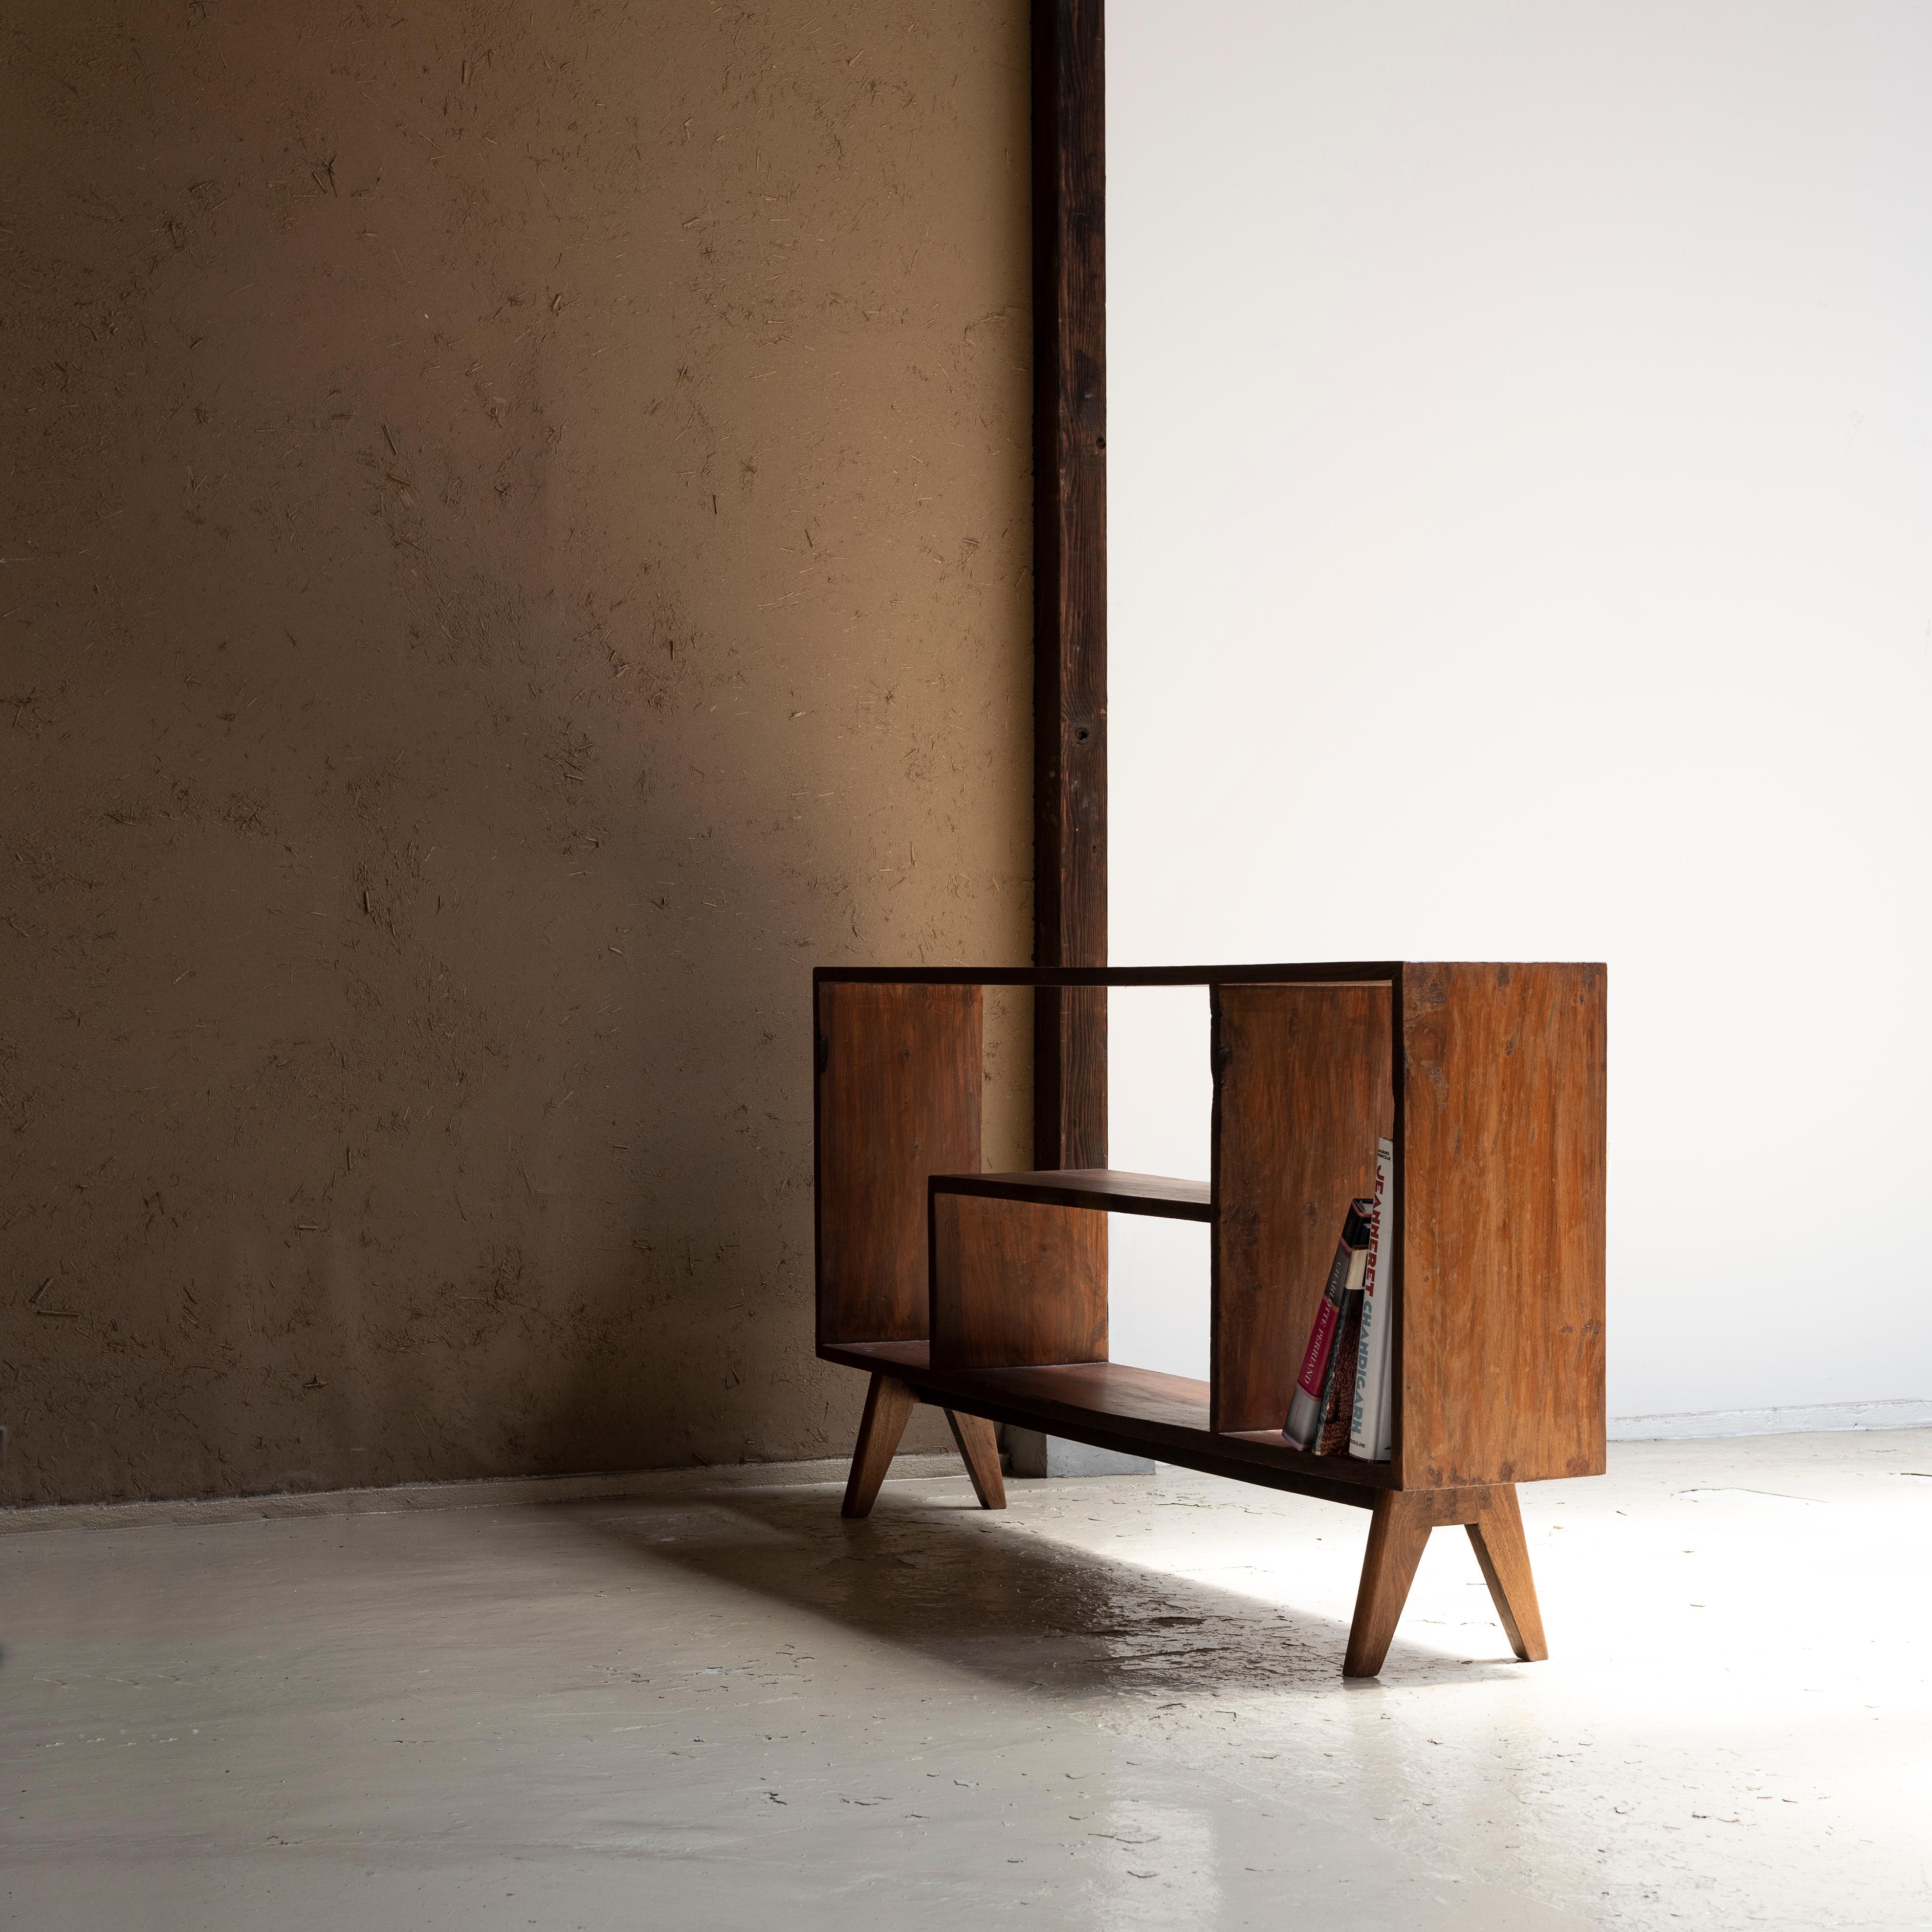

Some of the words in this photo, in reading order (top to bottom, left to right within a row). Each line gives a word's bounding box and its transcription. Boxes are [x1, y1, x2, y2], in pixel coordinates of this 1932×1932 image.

[1364, 1165, 1385, 1297] JEANNERET
[1320, 1262, 1341, 1327] CHARLOTTE
[1304, 1328, 1324, 1384] PERRIAND
[1352, 1300, 1372, 1434] CHANDIGARH
